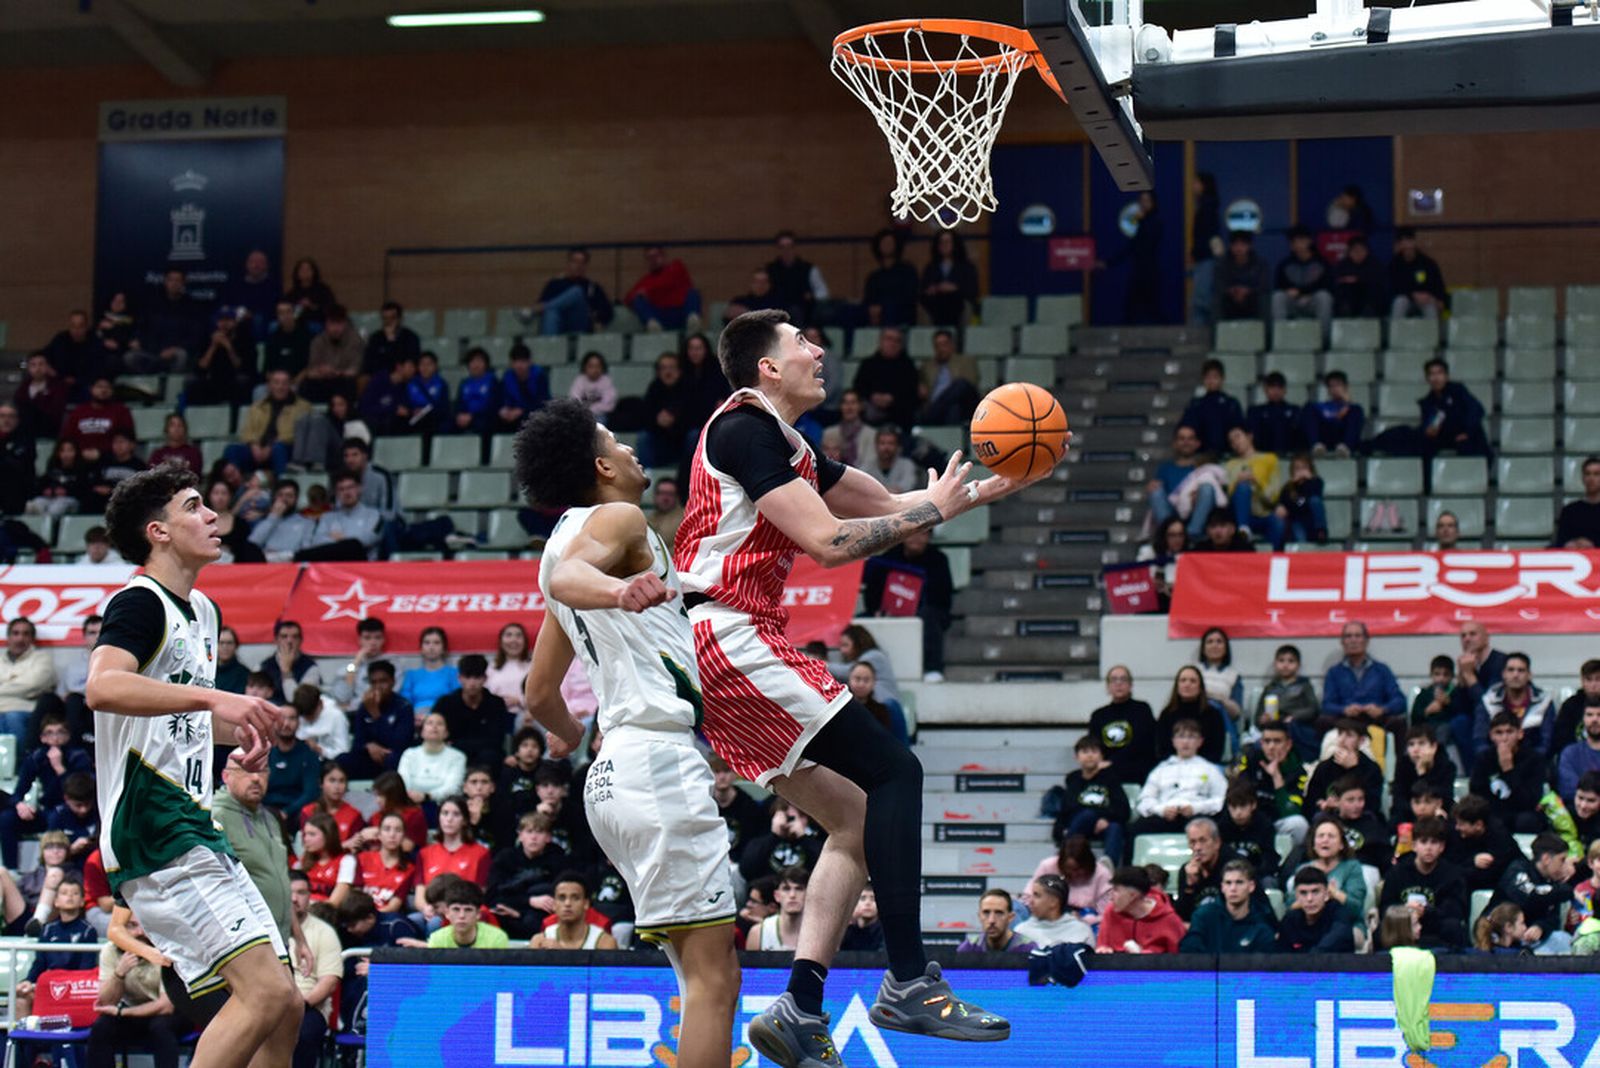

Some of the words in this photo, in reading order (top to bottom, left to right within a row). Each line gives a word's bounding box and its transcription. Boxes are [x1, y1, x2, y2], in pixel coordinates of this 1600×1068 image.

[107, 109, 192, 131] Grada
[204, 106, 277, 128] Norte
[1267, 552, 1600, 607] LIBER
[186, 757, 203, 795] 14
[495, 992, 900, 1068] LIBA
[1236, 999, 1600, 1068] LIBER
